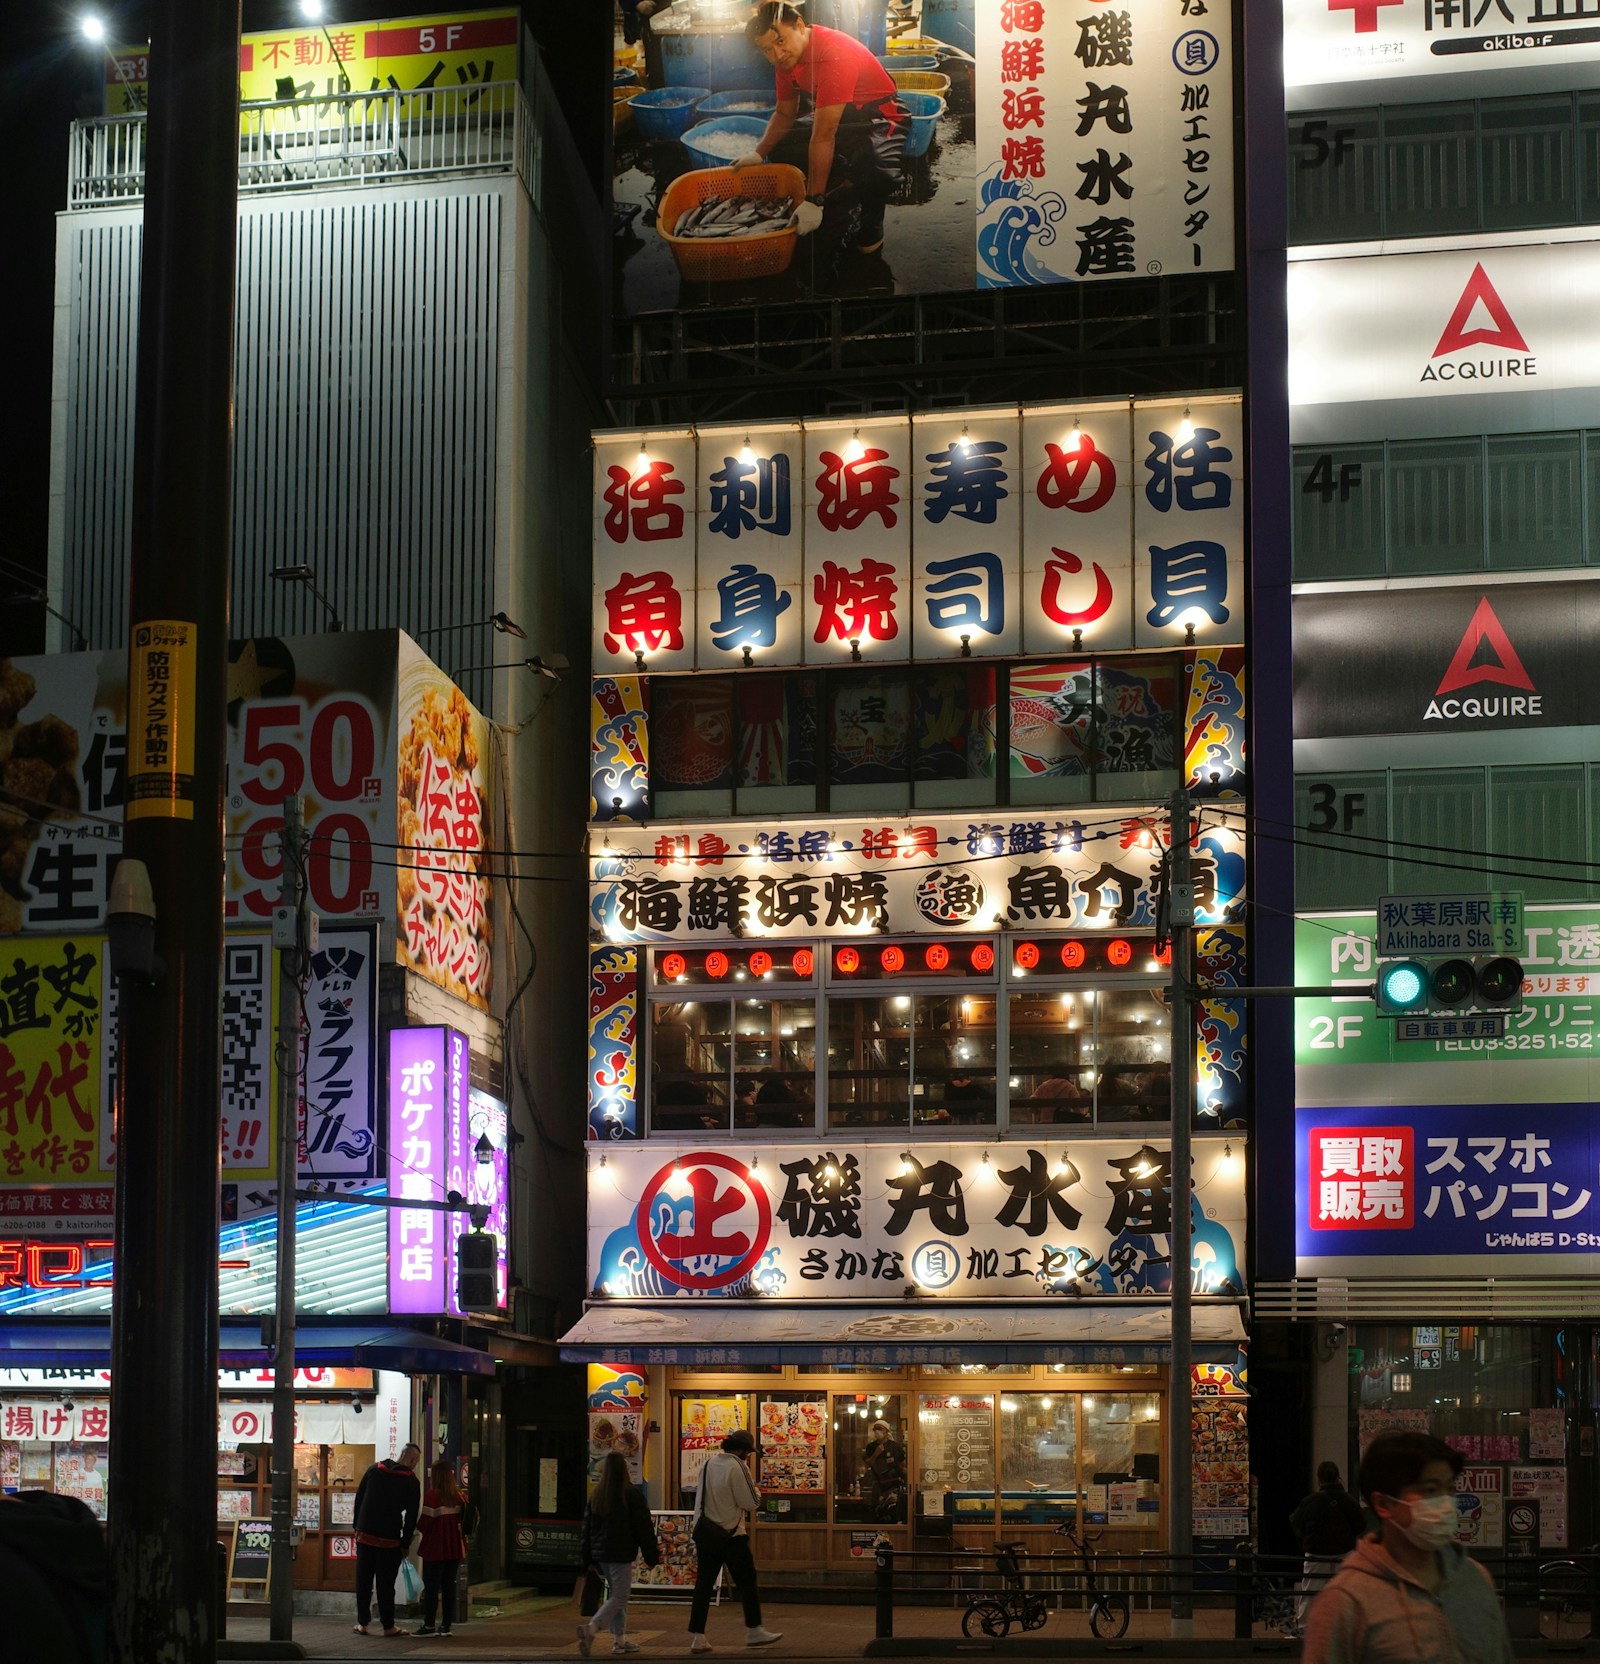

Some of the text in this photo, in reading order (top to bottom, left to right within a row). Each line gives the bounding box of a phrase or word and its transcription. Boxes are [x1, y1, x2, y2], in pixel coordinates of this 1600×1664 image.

[262, 31, 356, 69] 不動産
[1074, 10, 1136, 277] 磯丸水産
[1300, 121, 1355, 169] 5F
[1420, 357, 1537, 382] ACQUIRE
[1303, 453, 1362, 503] 4F
[814, 447, 899, 643] 浜焼
[924, 441, 1008, 636] 寿司
[1037, 434, 1117, 627] めし
[1145, 428, 1232, 630] 活貝
[603, 461, 685, 655] 活魚
[709, 453, 792, 650] 刺身
[146, 651, 170, 767] 防犯カメラ作動中
[1423, 696, 1543, 720] ACQUIRE
[1308, 783, 1365, 834] 3F
[618, 871, 889, 931] 海鮮浜焼
[1383, 900, 1517, 928] 秋葉原駅南
[1386, 931, 1461, 950] Akihabara
[1522, 976, 1590, 994] あります
[1308, 1015, 1364, 1049] 2F
[1405, 1020, 1496, 1037] 自転車専用
[1433, 1034, 1600, 1052] TEL03-3251-52
[453, 1036, 463, 1157] Pokemon
[4, 1135, 94, 1174] を作る
[400, 1060, 435, 1282] ポケカ専門店
[1319, 1136, 1405, 1178] 買取
[1425, 1132, 1553, 1175] スマホ
[79, 1193, 115, 1211] 激安
[776, 1145, 1196, 1238] 磯丸水産
[1319, 1179, 1405, 1221] 販売
[1423, 1180, 1592, 1221] パソコン
[5, 1406, 108, 1437] 揚げ皮
[1513, 1470, 1551, 1480] 献血状況
